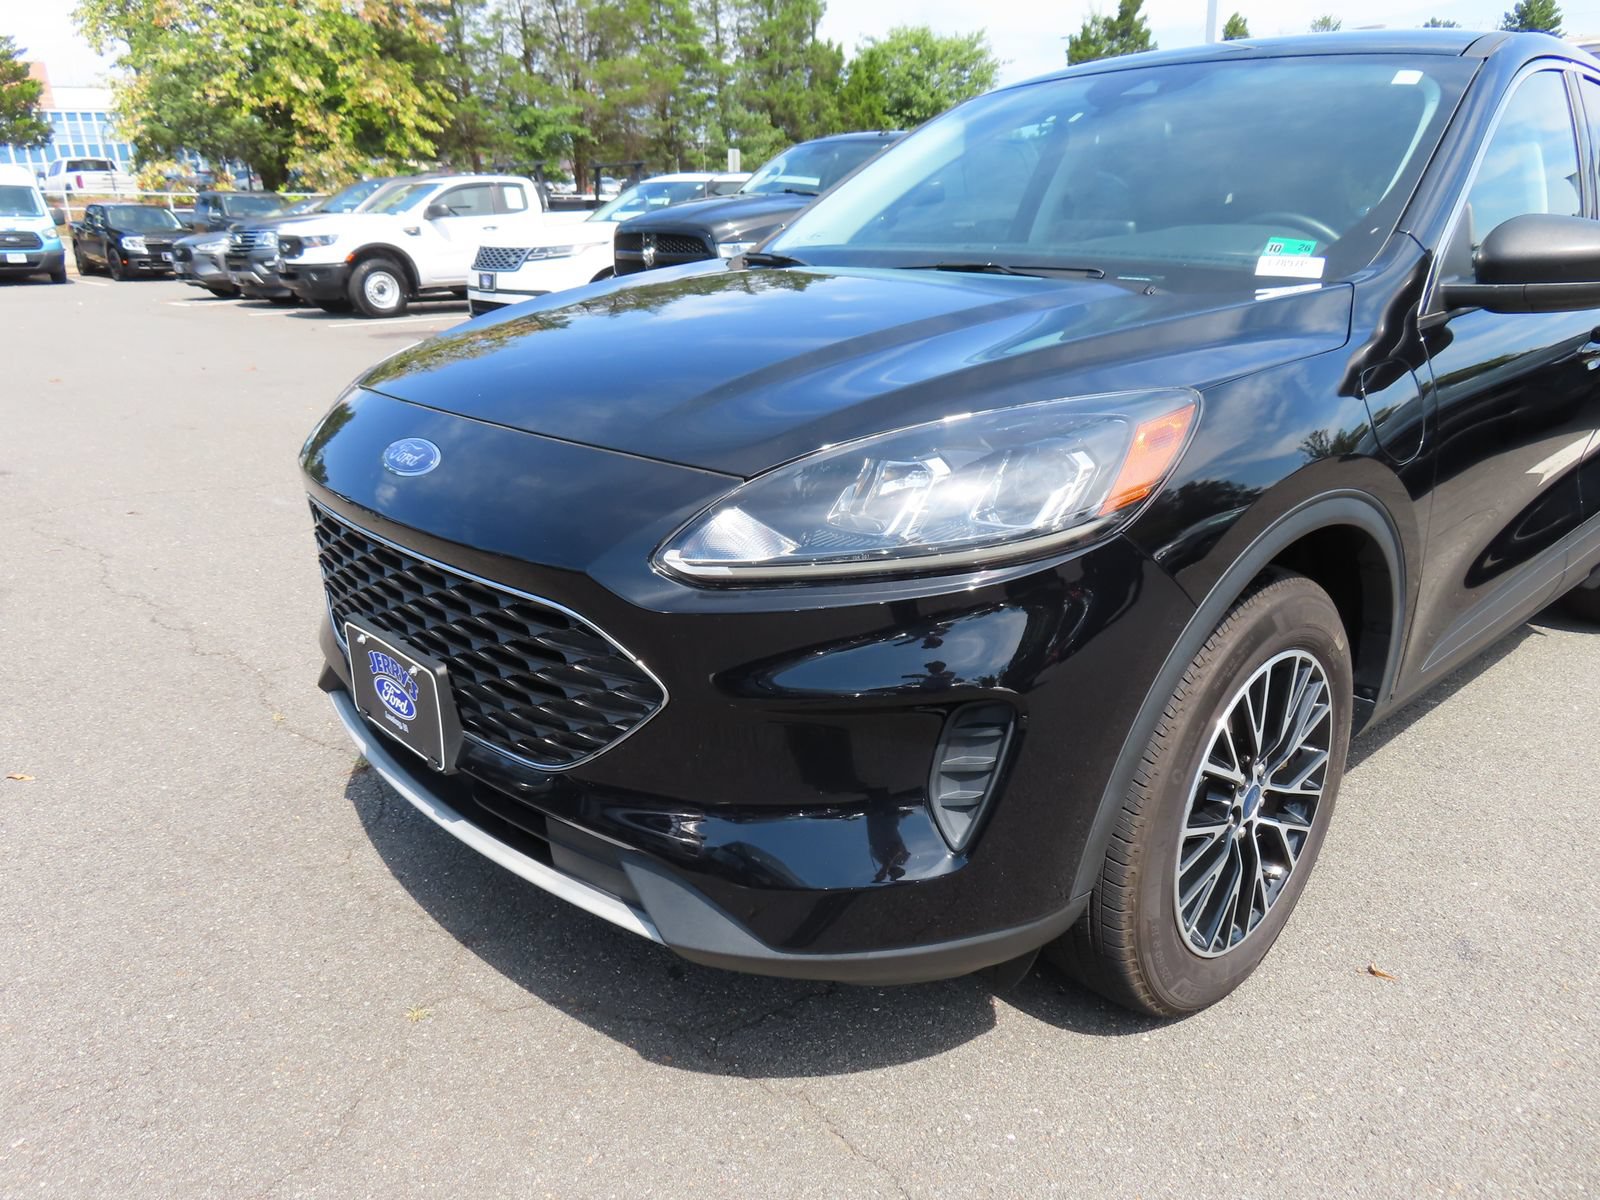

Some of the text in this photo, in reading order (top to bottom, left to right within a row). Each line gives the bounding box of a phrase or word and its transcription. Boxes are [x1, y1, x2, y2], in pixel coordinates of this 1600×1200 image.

[1268, 243, 1282, 253] 10
[389, 442, 425, 467] Ford
[382, 681, 409, 714] Ford
